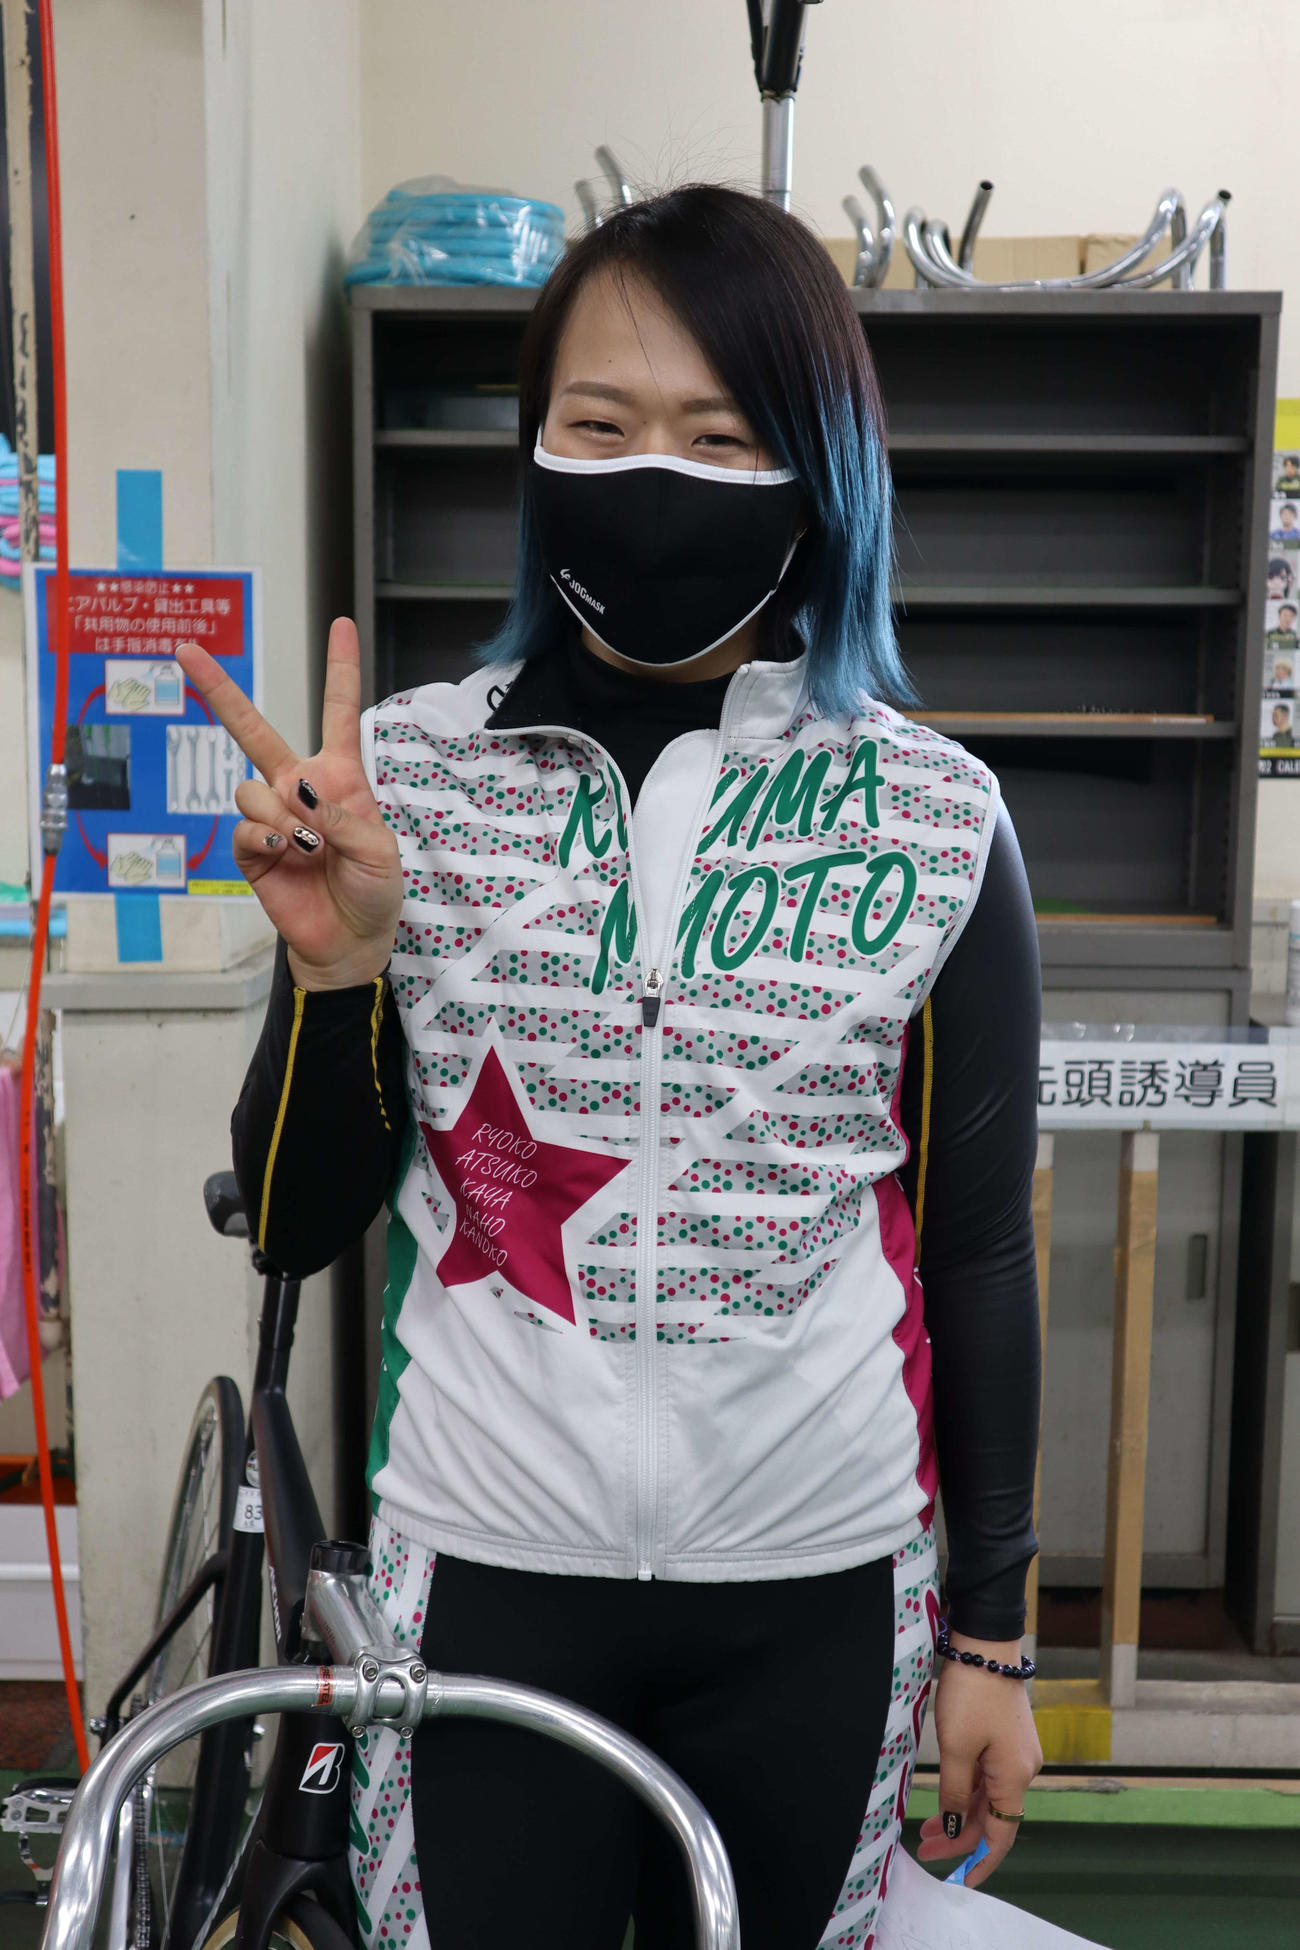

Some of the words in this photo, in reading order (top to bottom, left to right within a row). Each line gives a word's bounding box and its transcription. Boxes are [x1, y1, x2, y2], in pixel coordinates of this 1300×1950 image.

[471, 1123, 538, 1160] RYOKO
[455, 1149, 538, 1188] ATSUKO
[459, 1177, 513, 1210] KAYA
[465, 1204, 506, 1237] NAHO
[459, 1220, 508, 1266] KANOKO
